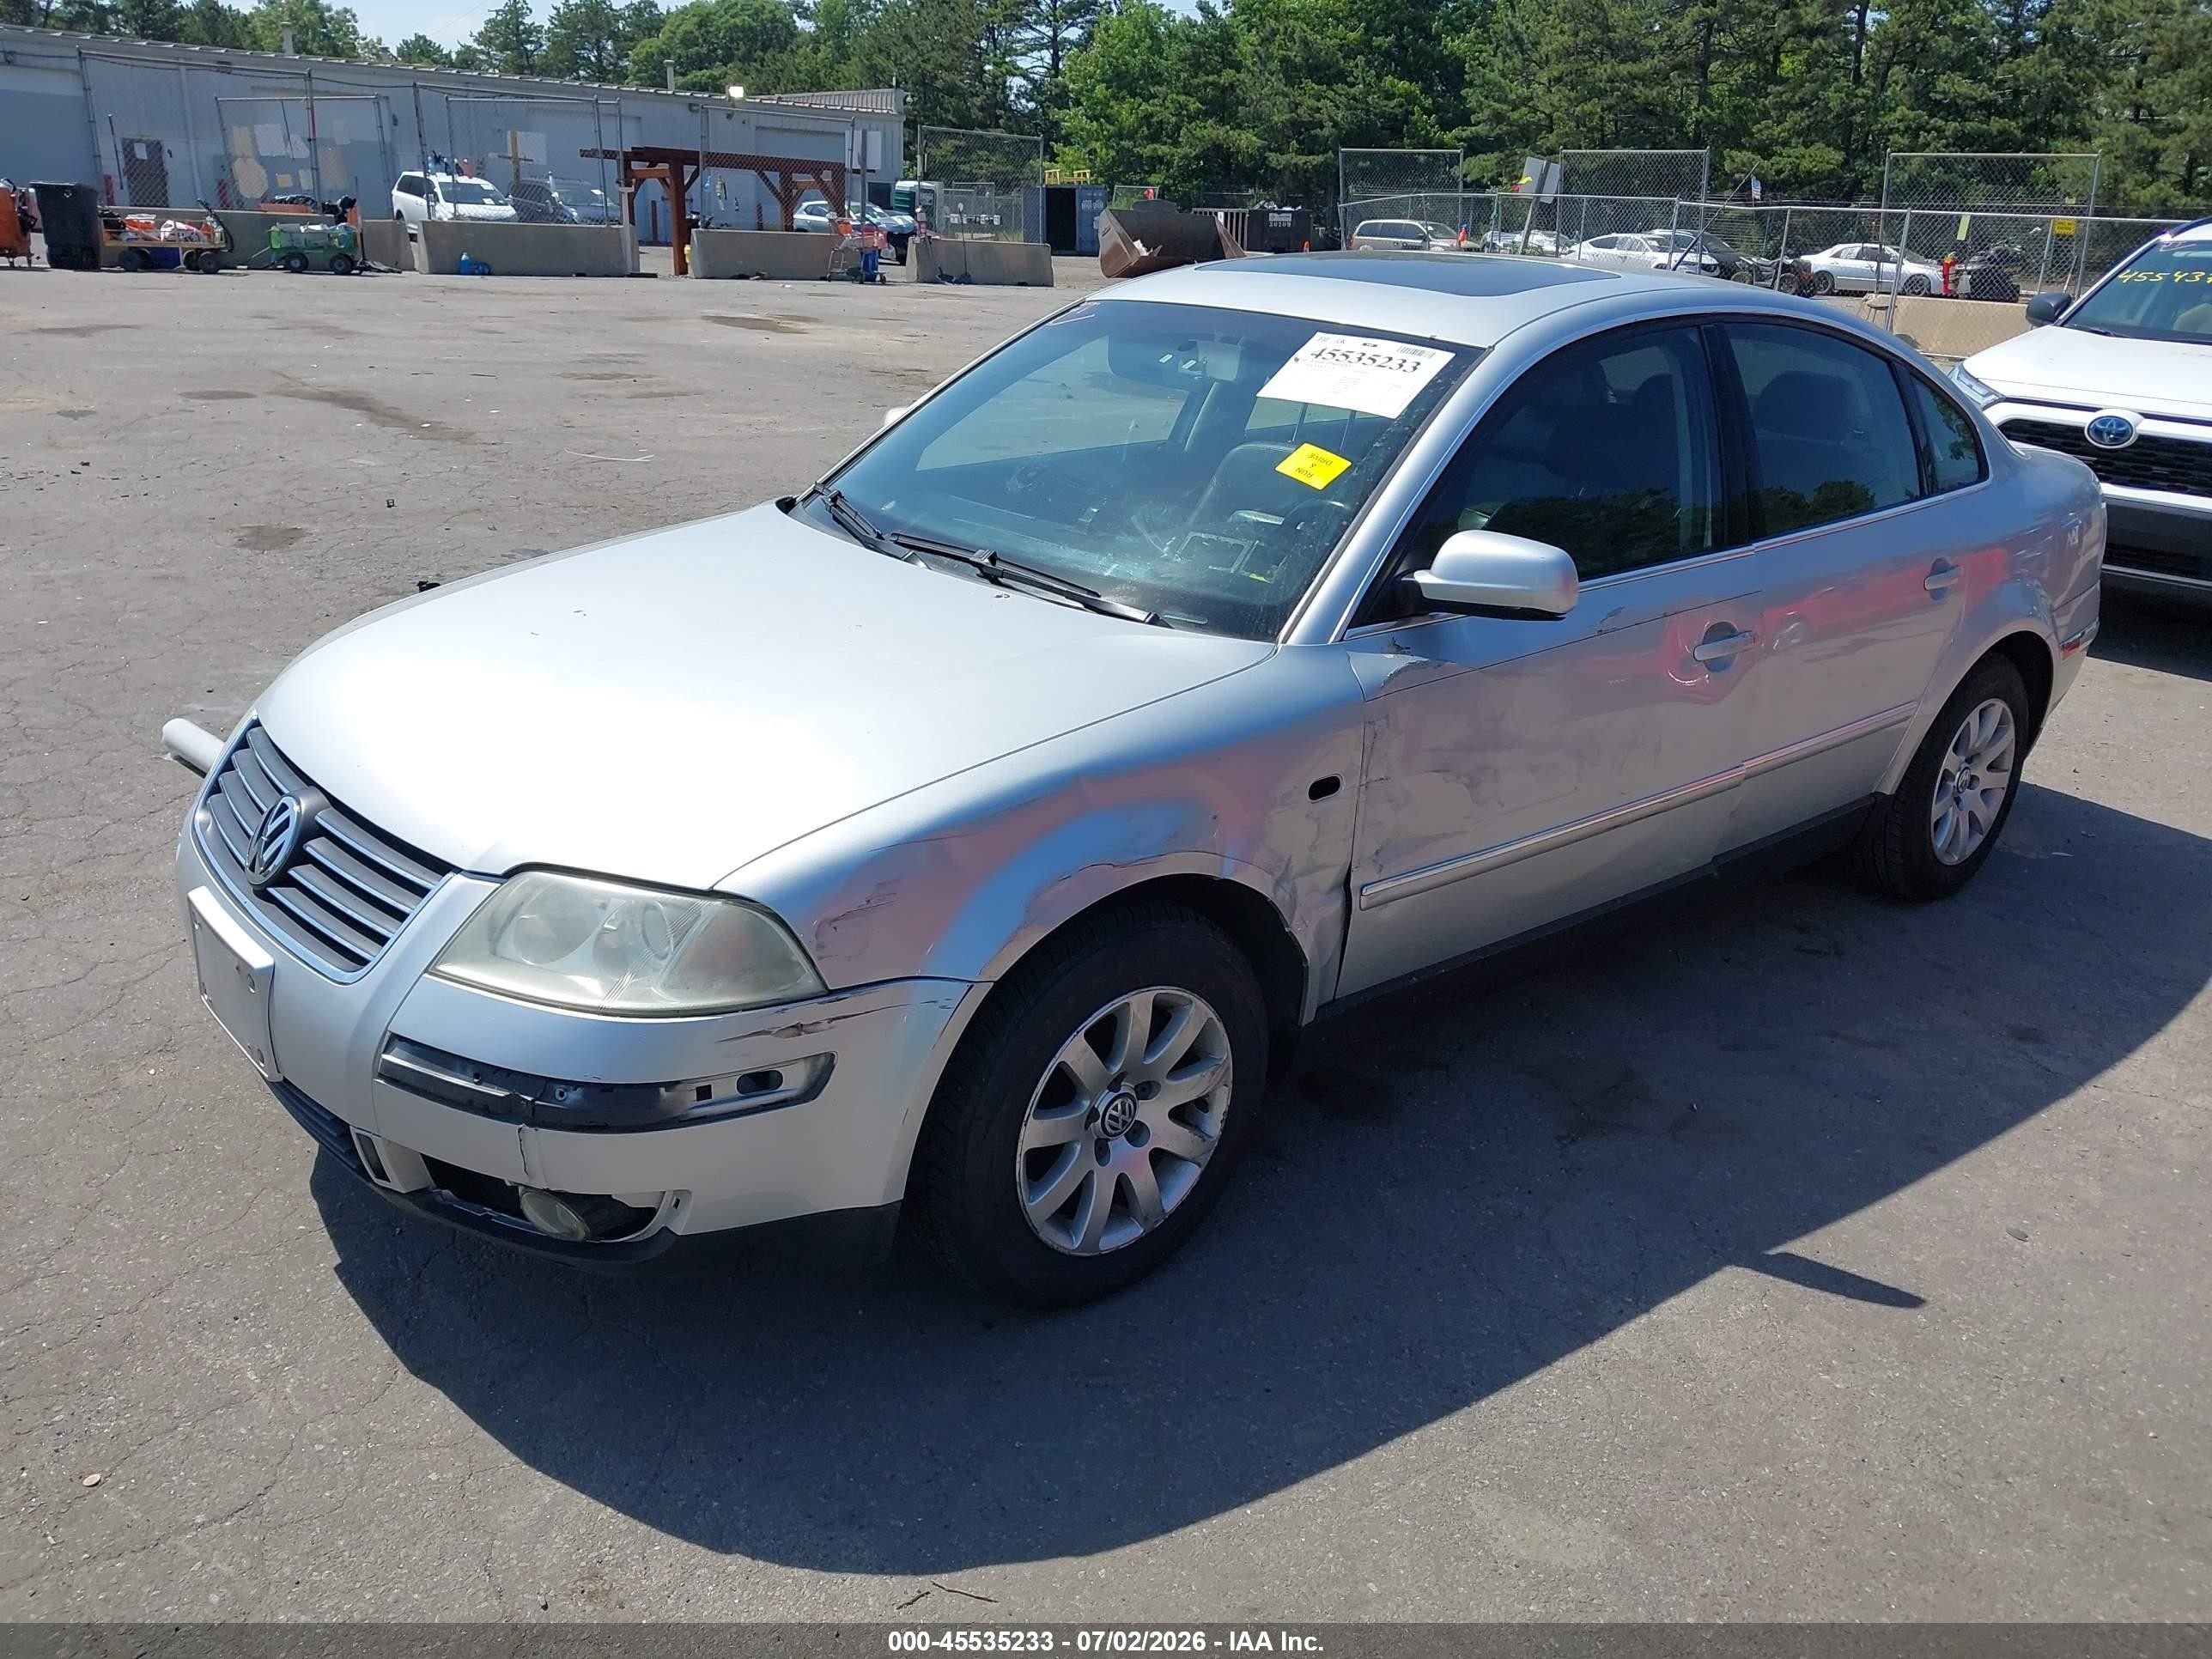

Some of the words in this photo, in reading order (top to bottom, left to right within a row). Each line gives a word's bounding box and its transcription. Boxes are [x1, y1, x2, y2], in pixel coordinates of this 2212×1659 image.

[1310, 348, 1421, 374] 45535233
[1307, 453, 1334, 466] DRIVE
[1295, 467, 1315, 478] RUN
